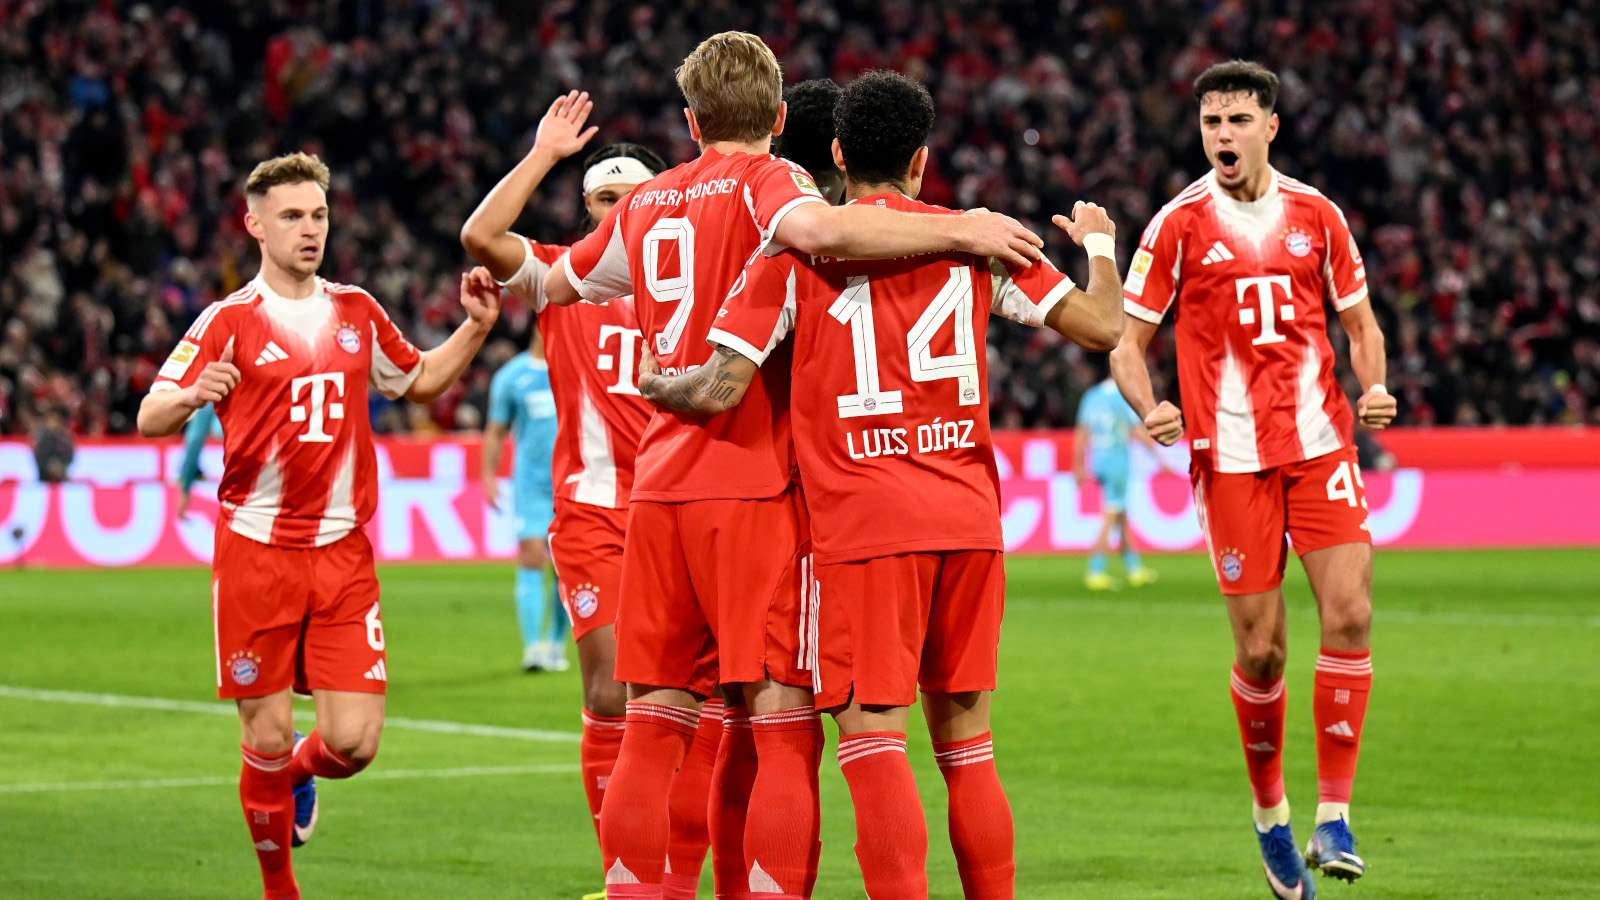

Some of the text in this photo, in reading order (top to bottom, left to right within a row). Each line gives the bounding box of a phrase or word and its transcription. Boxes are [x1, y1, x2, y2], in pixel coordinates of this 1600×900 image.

[643, 216, 695, 355] 9
[1235, 275, 1295, 346] T
[827, 265, 981, 419] 14
[290, 372, 344, 442] T
[847, 417, 976, 460] LUIS DÍAZ
[365, 601, 385, 651] 6
